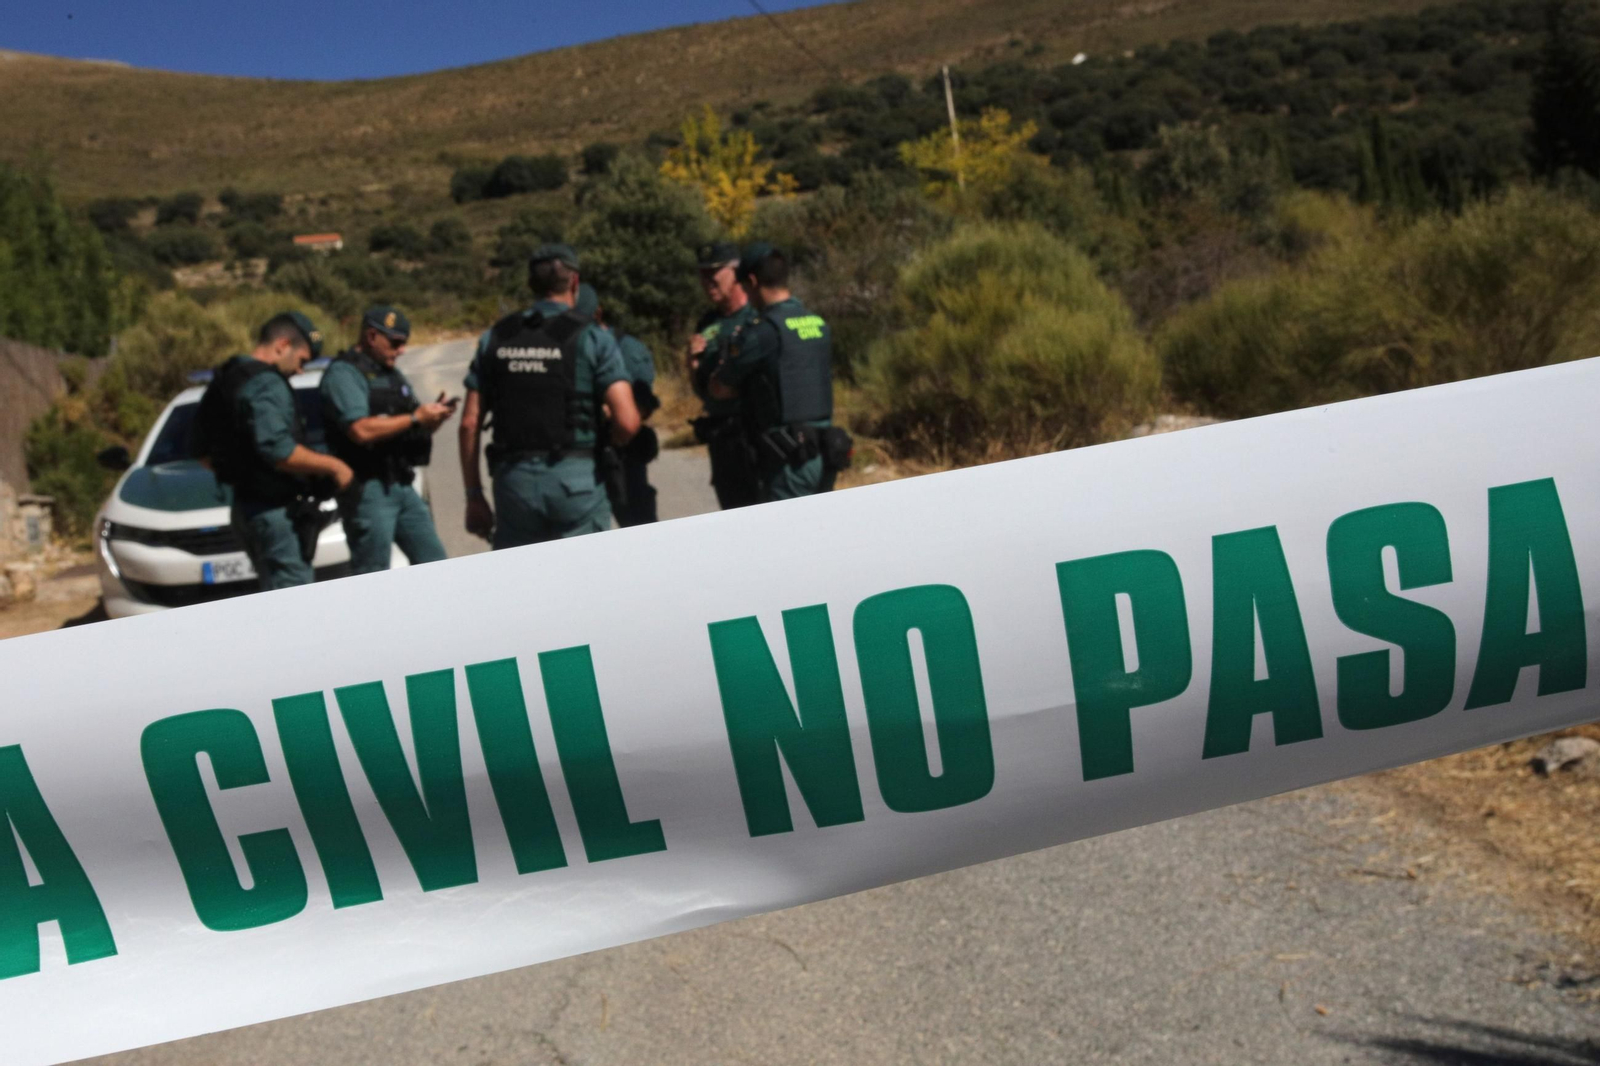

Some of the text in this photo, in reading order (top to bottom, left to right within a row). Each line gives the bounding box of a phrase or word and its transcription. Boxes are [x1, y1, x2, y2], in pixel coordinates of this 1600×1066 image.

[497, 347, 562, 360] GUARDIA
[508, 360, 548, 373] CIVIL
[141, 645, 667, 932] CIVIL
[708, 585, 995, 837] NO
[1056, 478, 1588, 781] PASA
